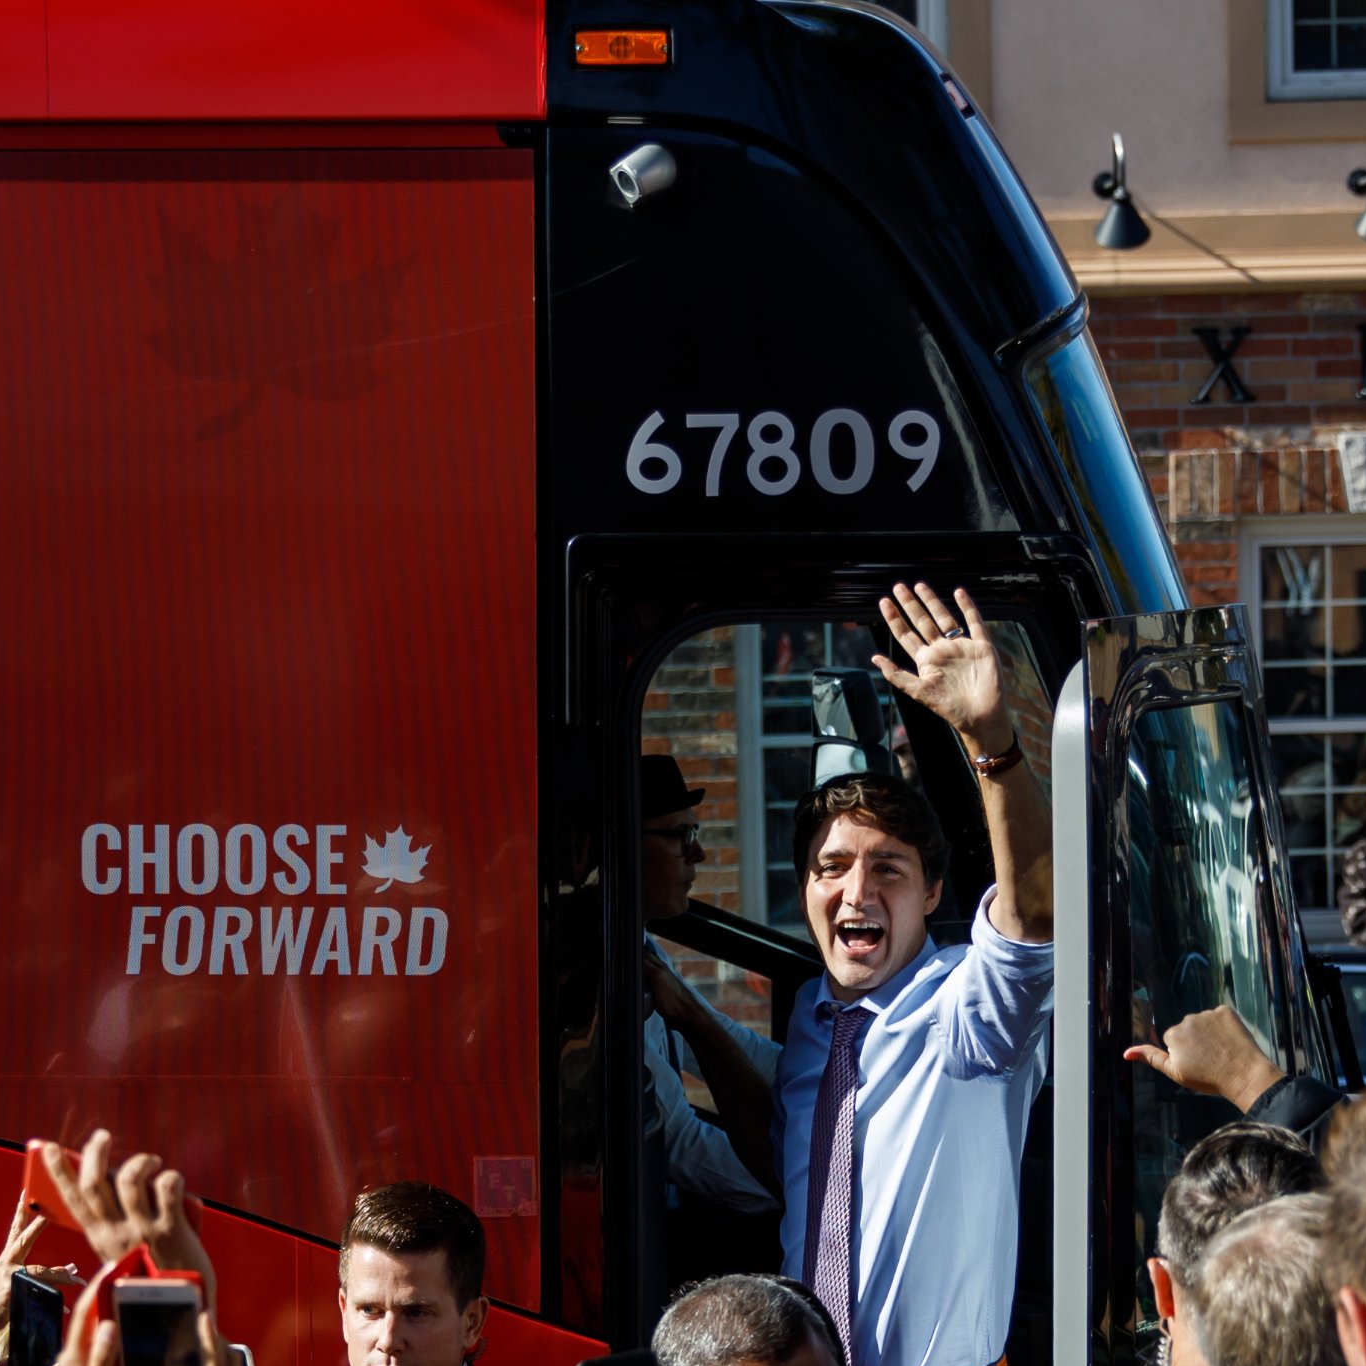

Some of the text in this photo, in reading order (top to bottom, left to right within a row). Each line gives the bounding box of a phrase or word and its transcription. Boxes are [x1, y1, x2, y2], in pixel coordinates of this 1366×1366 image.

[626, 408, 940, 497] 67809
[81, 823, 348, 895] CHOOSE
[125, 906, 449, 976] FORWARD
